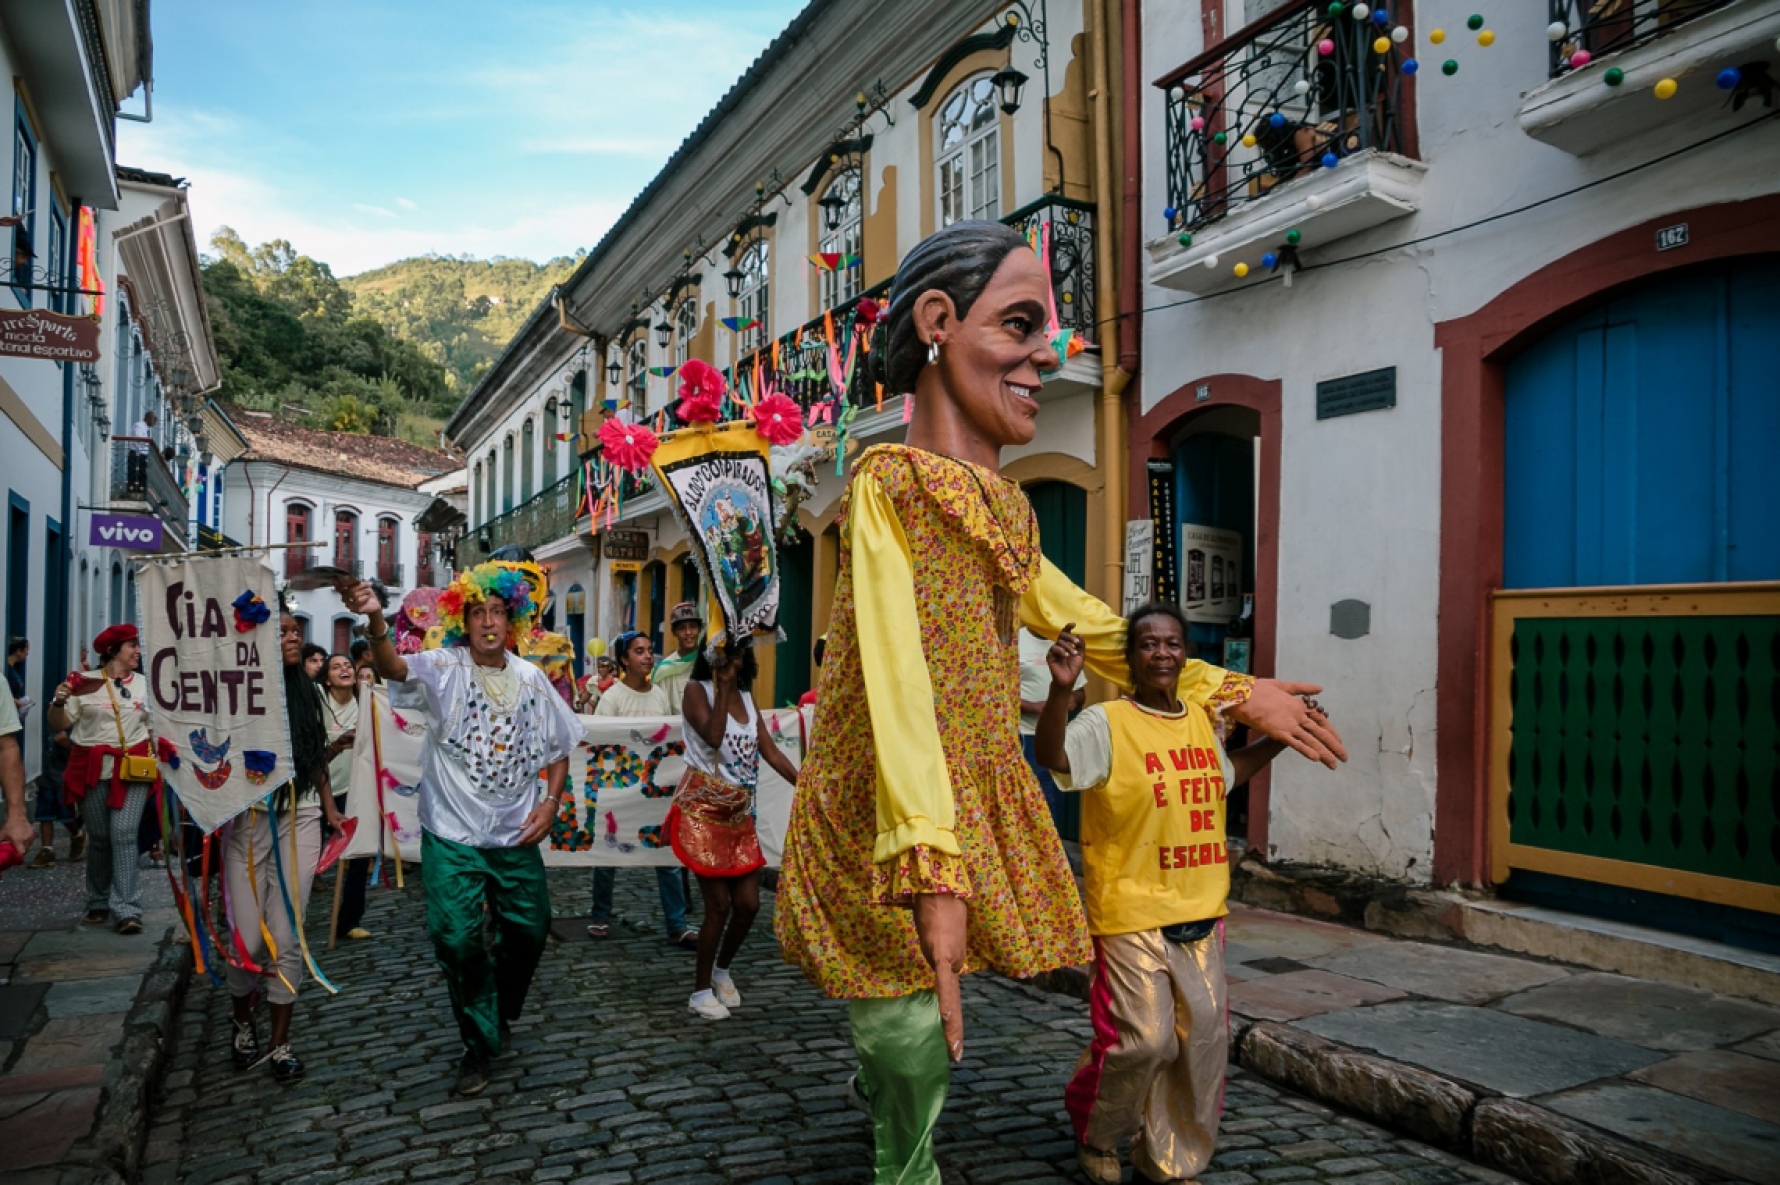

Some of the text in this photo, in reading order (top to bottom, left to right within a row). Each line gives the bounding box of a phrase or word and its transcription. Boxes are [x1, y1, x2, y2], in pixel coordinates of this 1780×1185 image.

[1660, 227, 1684, 246] 162
[5, 331, 46, 343] moda
[0, 341, 93, 358] terial esportivo
[98, 521, 154, 543] vivo
[236, 641, 260, 667] DA
[151, 647, 266, 716] GENTE
[1145, 743, 1221, 775] A VIDA
[1153, 772, 1227, 809] É FEIT
[1190, 810, 1215, 833] DE
[1158, 841, 1229, 870] ESCOL
